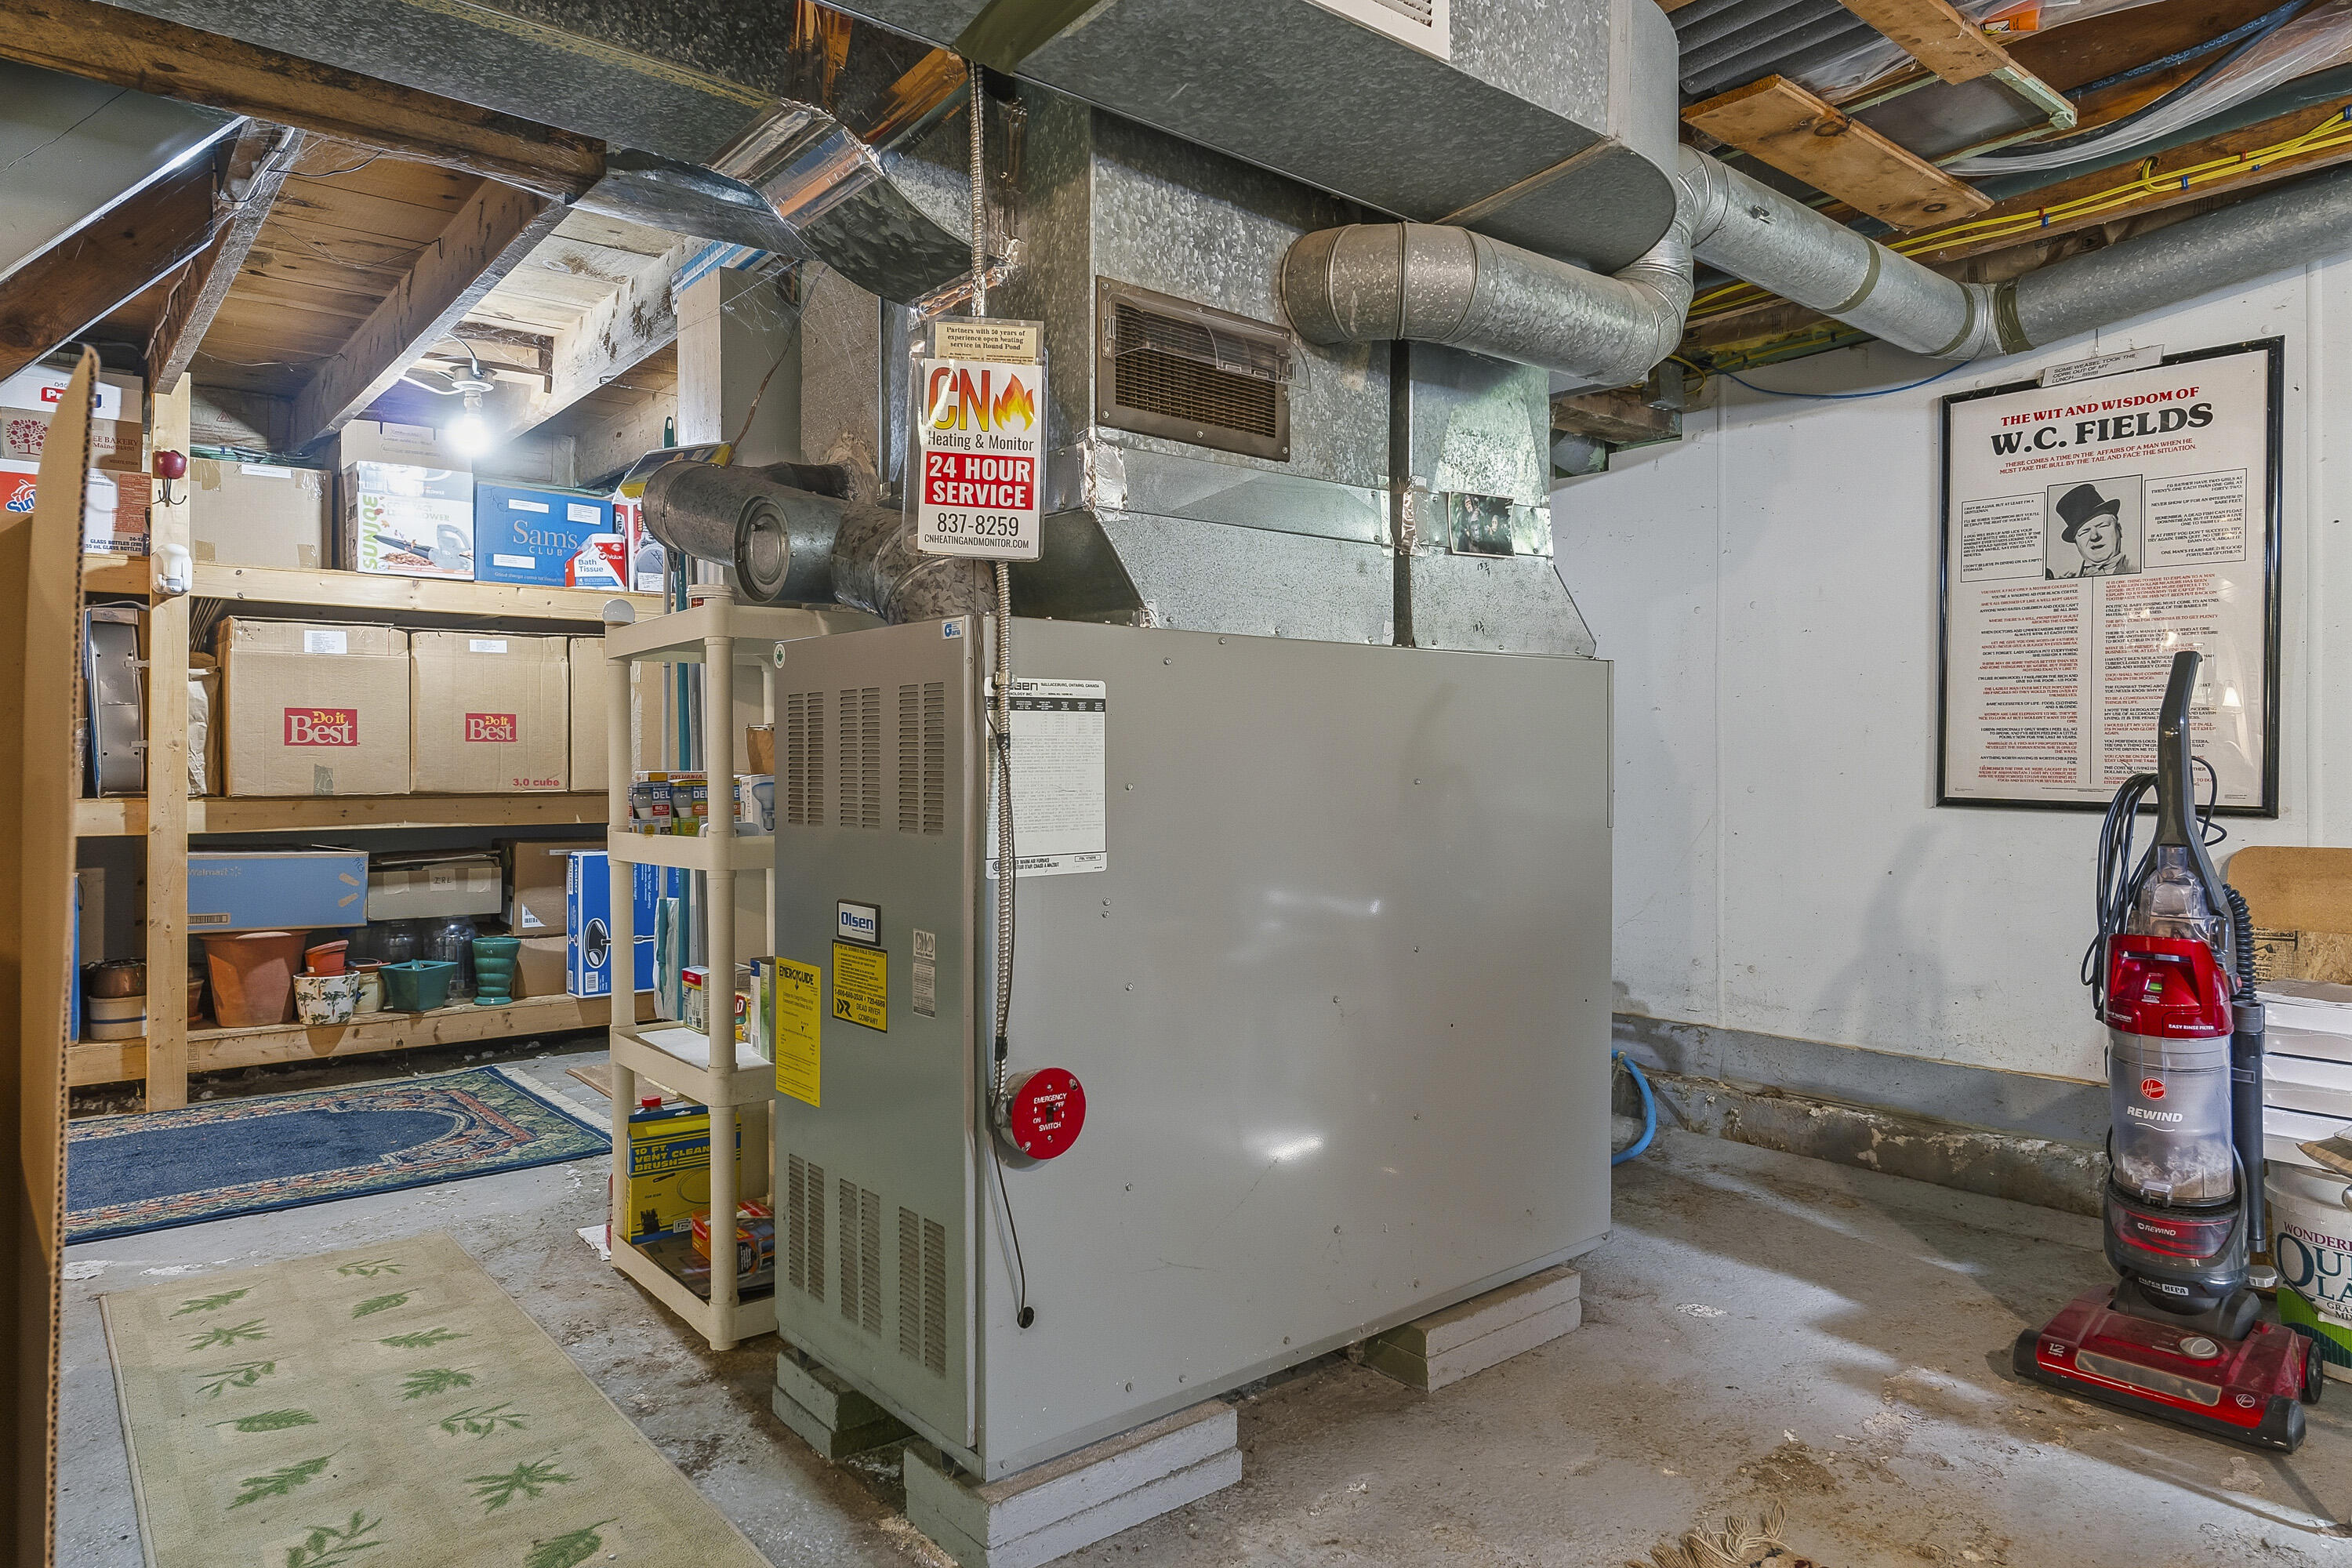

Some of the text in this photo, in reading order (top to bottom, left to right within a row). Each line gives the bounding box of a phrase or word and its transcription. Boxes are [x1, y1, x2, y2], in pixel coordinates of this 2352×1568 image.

[2203, 34, 2228, 49] COLD
[2074, 361, 2100, 369] WEASEL
[928, 368, 991, 432] CN
[2002, 387, 2200, 426] THE WIT AND WISDOM OF
[1991, 403, 2213, 455] W.C. FIELDS
[104, 437, 138, 446] BAKERY
[928, 430, 1034, 451] Heating & Monitor
[2096, 447, 2125, 456] AFFAIRS
[2157, 444, 2197, 454] SITUATION.
[929, 456, 1030, 482] 24 HOUR
[932, 481, 1026, 507] SERVICE
[938, 513, 1018, 536] 837-8259
[514, 520, 578, 549] Sam's
[924, 535, 1029, 548] CNHEATINGANDMONITOR.COM
[529, 546, 562, 556] CLUB
[313, 712, 347, 724] Do it
[485, 716, 508, 726] Do it
[289, 715, 353, 744] Best
[468, 717, 514, 741] Best
[532, 778, 560, 787] cube
[841, 911, 873, 930] Olsen
[869, 1006, 880, 1015] RIVER
[858, 1013, 878, 1025] COMPANY
[1033, 1093, 1066, 1104] EMERGENCY
[2126, 1105, 2183, 1123] REWIND
[1039, 1121, 1061, 1131] SWITCH
[635, 1145, 710, 1163] VENT CLEAN
[652, 1145, 669, 1153] FT.
[635, 1159, 678, 1171] BRUSH
[2144, 1225, 2176, 1236] REWIND
[2315, 1275, 2352, 1303] LA
[2049, 1343, 2065, 1352] 12
